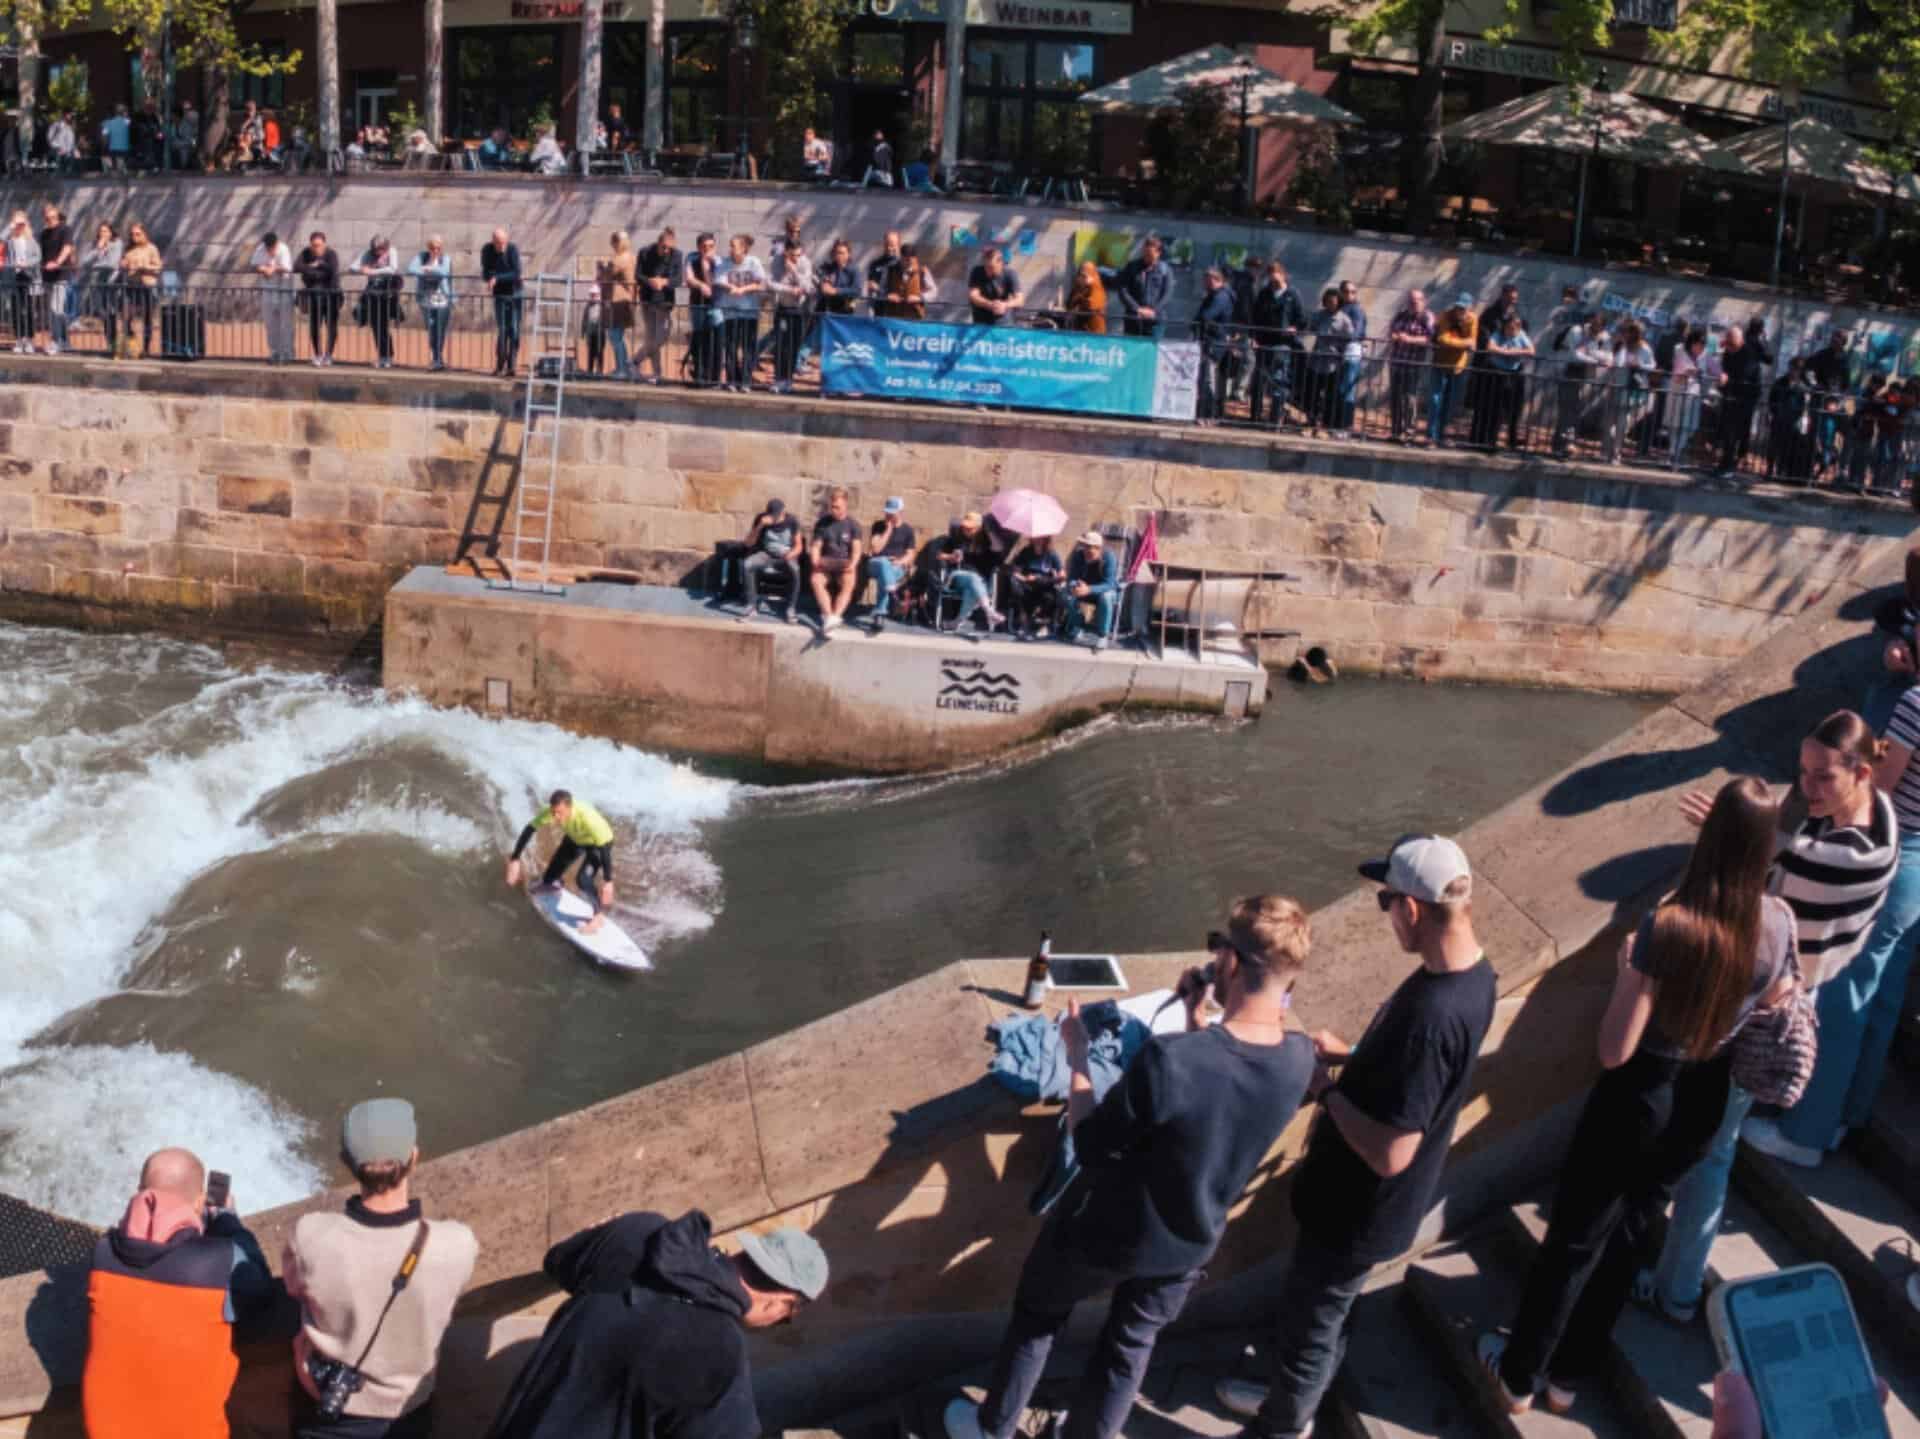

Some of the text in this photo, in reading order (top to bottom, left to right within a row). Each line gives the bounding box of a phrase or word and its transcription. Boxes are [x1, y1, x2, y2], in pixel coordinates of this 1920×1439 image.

[994, 2, 1092, 27] WEINBAR
[886, 330, 1126, 368] Vereinsmeisterschaft
[936, 695, 1018, 713] LEINEWELLE
